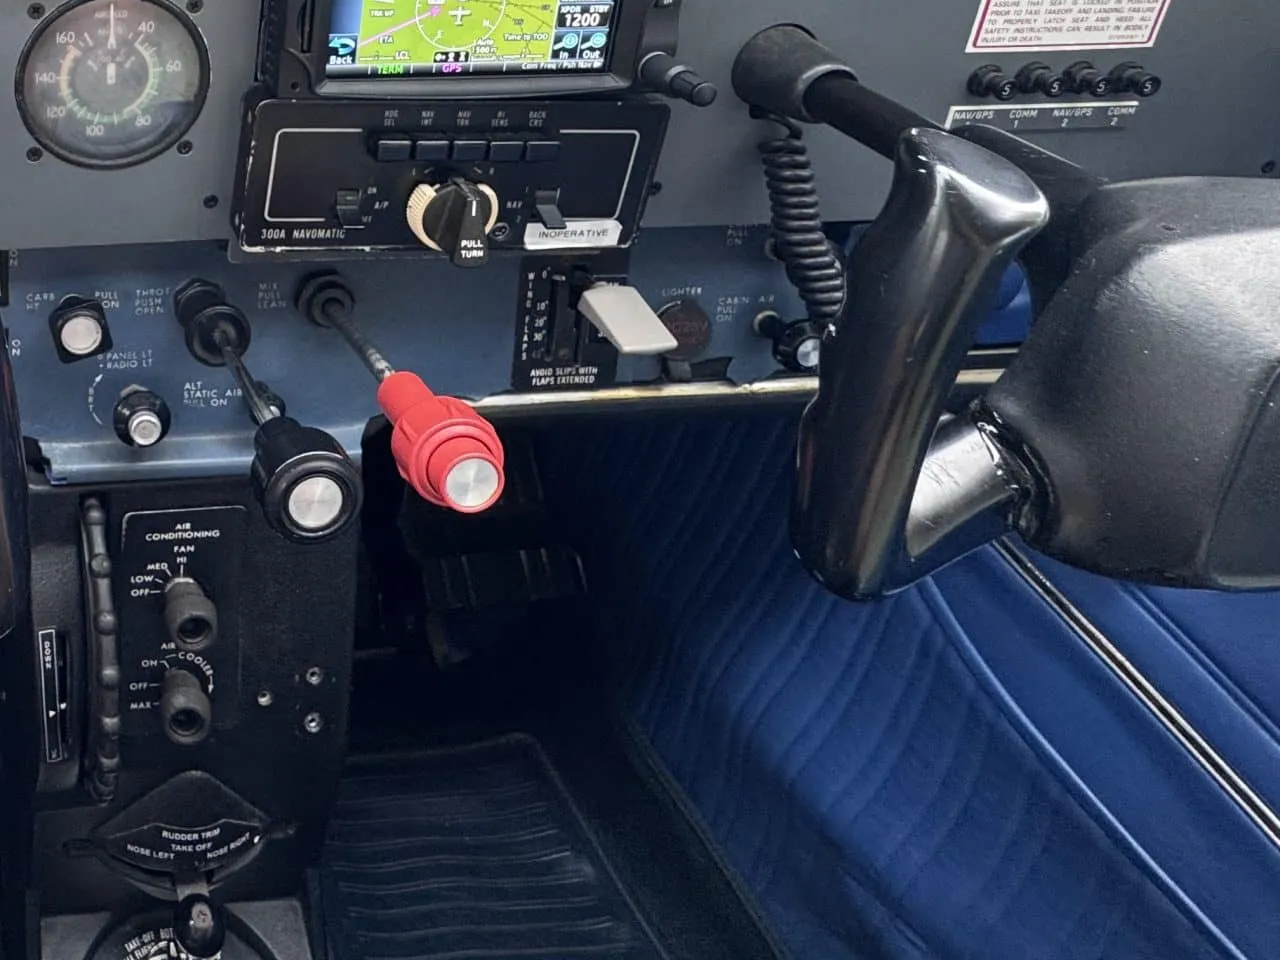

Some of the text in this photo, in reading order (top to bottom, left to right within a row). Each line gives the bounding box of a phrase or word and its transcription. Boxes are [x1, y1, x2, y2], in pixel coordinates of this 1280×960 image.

[564, 12, 600, 27] 1200
[138, 21, 154, 33] 40
[56, 31, 75, 44] 160
[165, 61, 181, 72] 60
[442, 63, 463, 74] GPS
[35, 72, 56, 84] 140
[46, 107, 65, 118] 120
[953, 110, 995, 120] NAV/GPS
[1009, 109, 1038, 119] COMM
[1052, 108, 1093, 118] NAV/GPS
[1107, 106, 1136, 116] COMM
[135, 116, 152, 127] 80
[85, 125, 104, 136] 100
[261, 227, 346, 239] 300A NAVOMATIC
[538, 227, 610, 239] INOPERATIVE
[460, 239, 484, 249] PULL
[460, 248, 484, 258] TURN
[95, 290, 118, 300] PULL
[136, 287, 171, 297] THROT
[661, 286, 702, 297] LIGHTER
[26, 292, 55, 302] CARB
[135, 297, 162, 307] PUSH
[135, 306, 164, 316] OPEN
[106, 351, 139, 361] PANEL
[530, 365, 598, 377] AVOID WITH
[532, 374, 595, 386] FLAPS EXTENDED
[184, 381, 202, 391] ALT
[183, 388, 218, 398] STATIC
[175, 522, 191, 530] AIR
[145, 529, 220, 541] CONDITIONING
[174, 544, 195, 553] FAN
[147, 563, 168, 572] MED
[130, 574, 154, 584] LOW
[131, 588, 149, 597] OFF
[130, 681, 148, 690] OFF
[130, 701, 151, 710] MAX
[162, 828, 220, 841] RUDDER TRIM
[171, 842, 212, 852] TAKE OFF
[153, 850, 175, 860] LEFT
